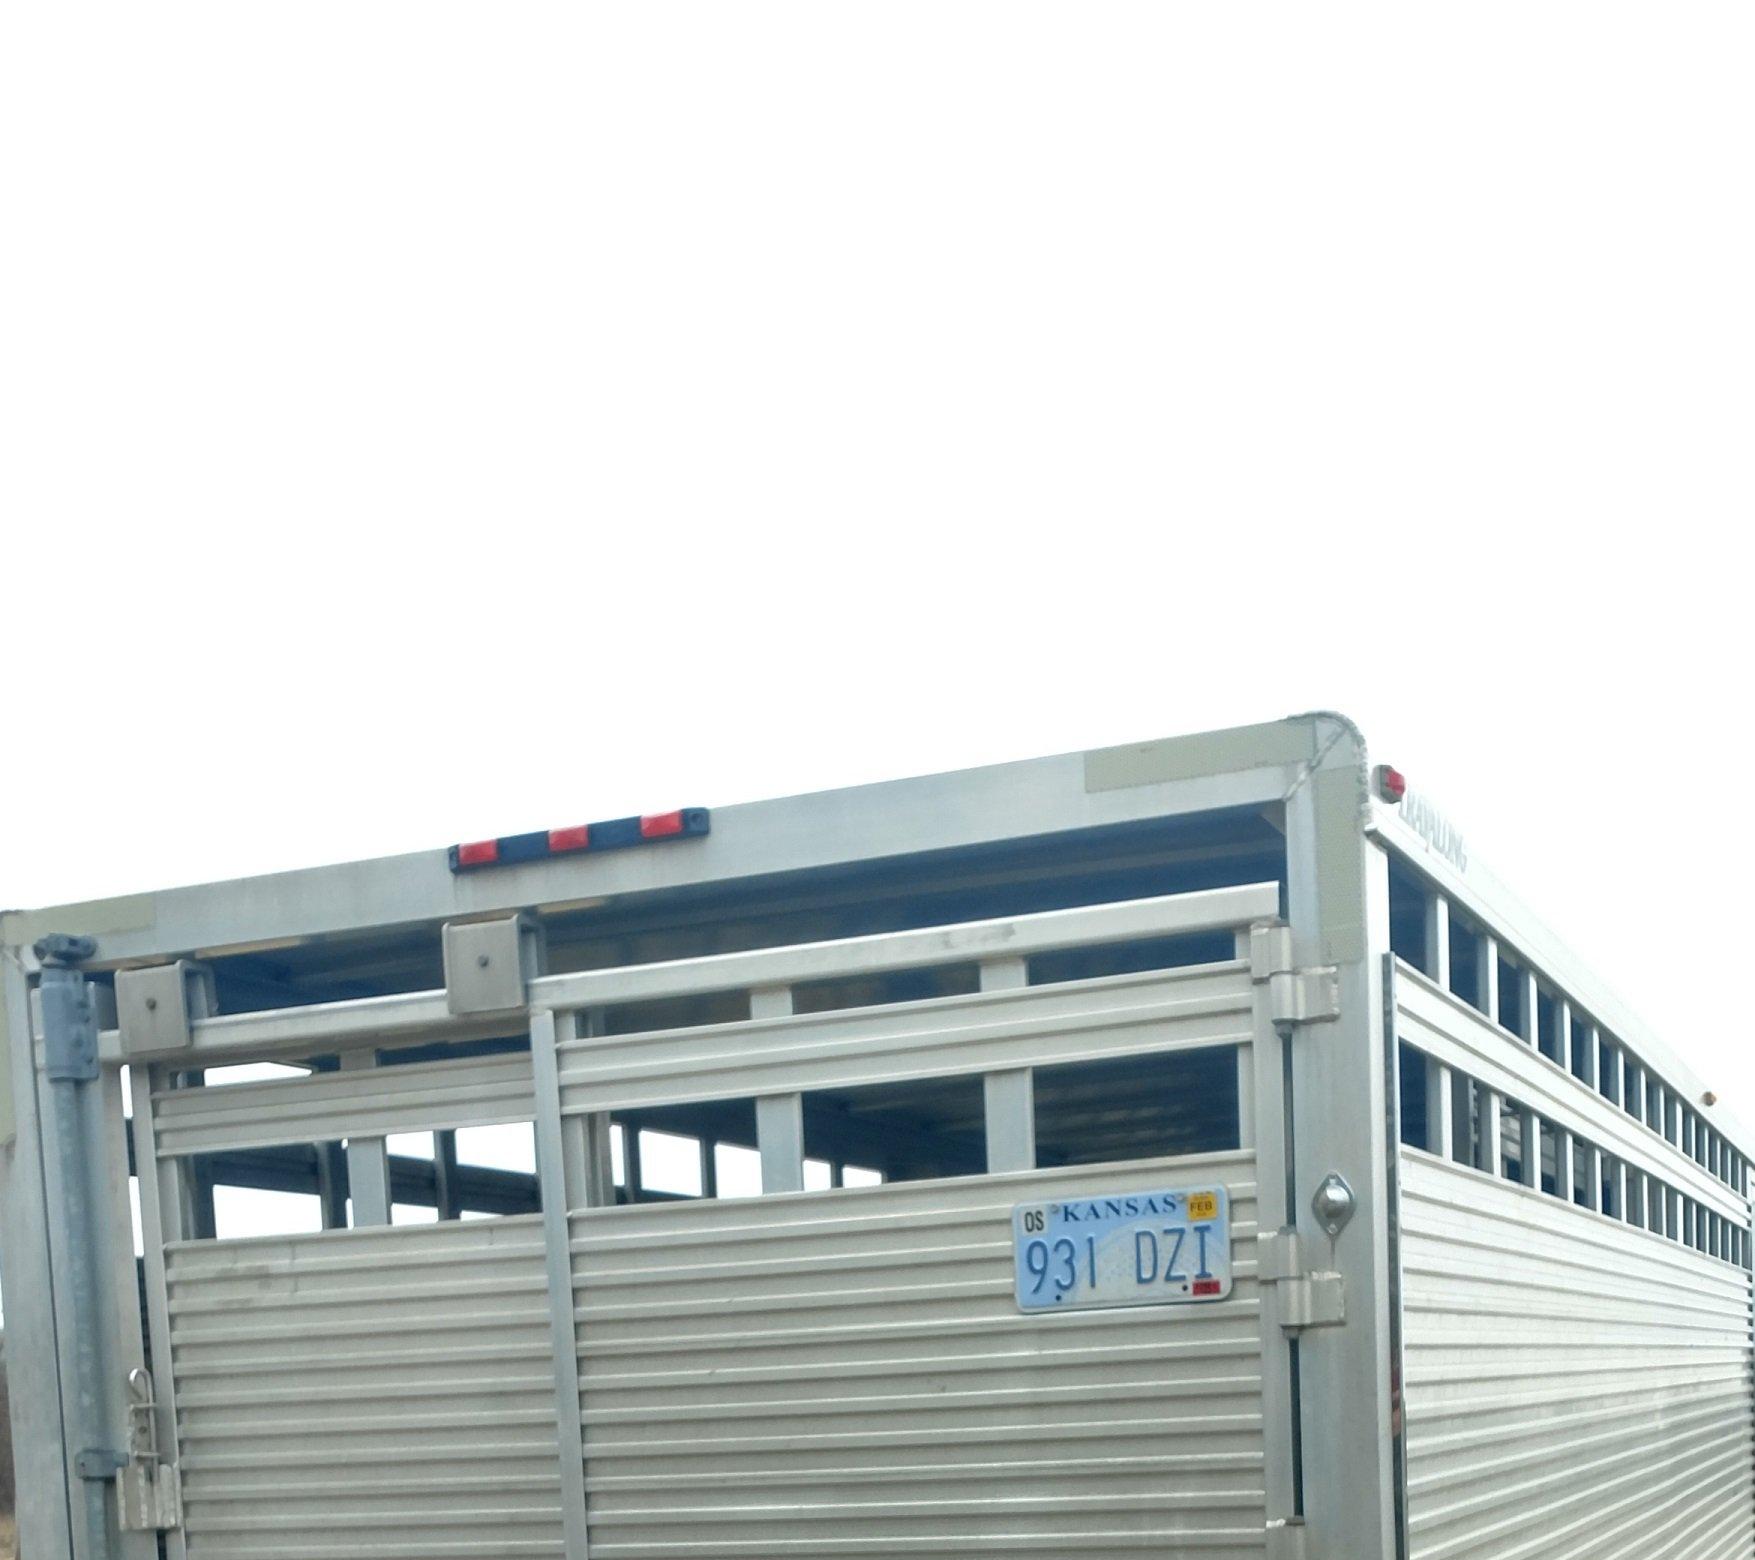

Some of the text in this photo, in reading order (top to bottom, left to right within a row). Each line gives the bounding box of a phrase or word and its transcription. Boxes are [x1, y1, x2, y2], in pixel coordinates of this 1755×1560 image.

[1024, 1210, 1044, 1233] OS
[1063, 1194, 1178, 1222] KANSAS
[1026, 1225, 1212, 1295] 931 DZI
